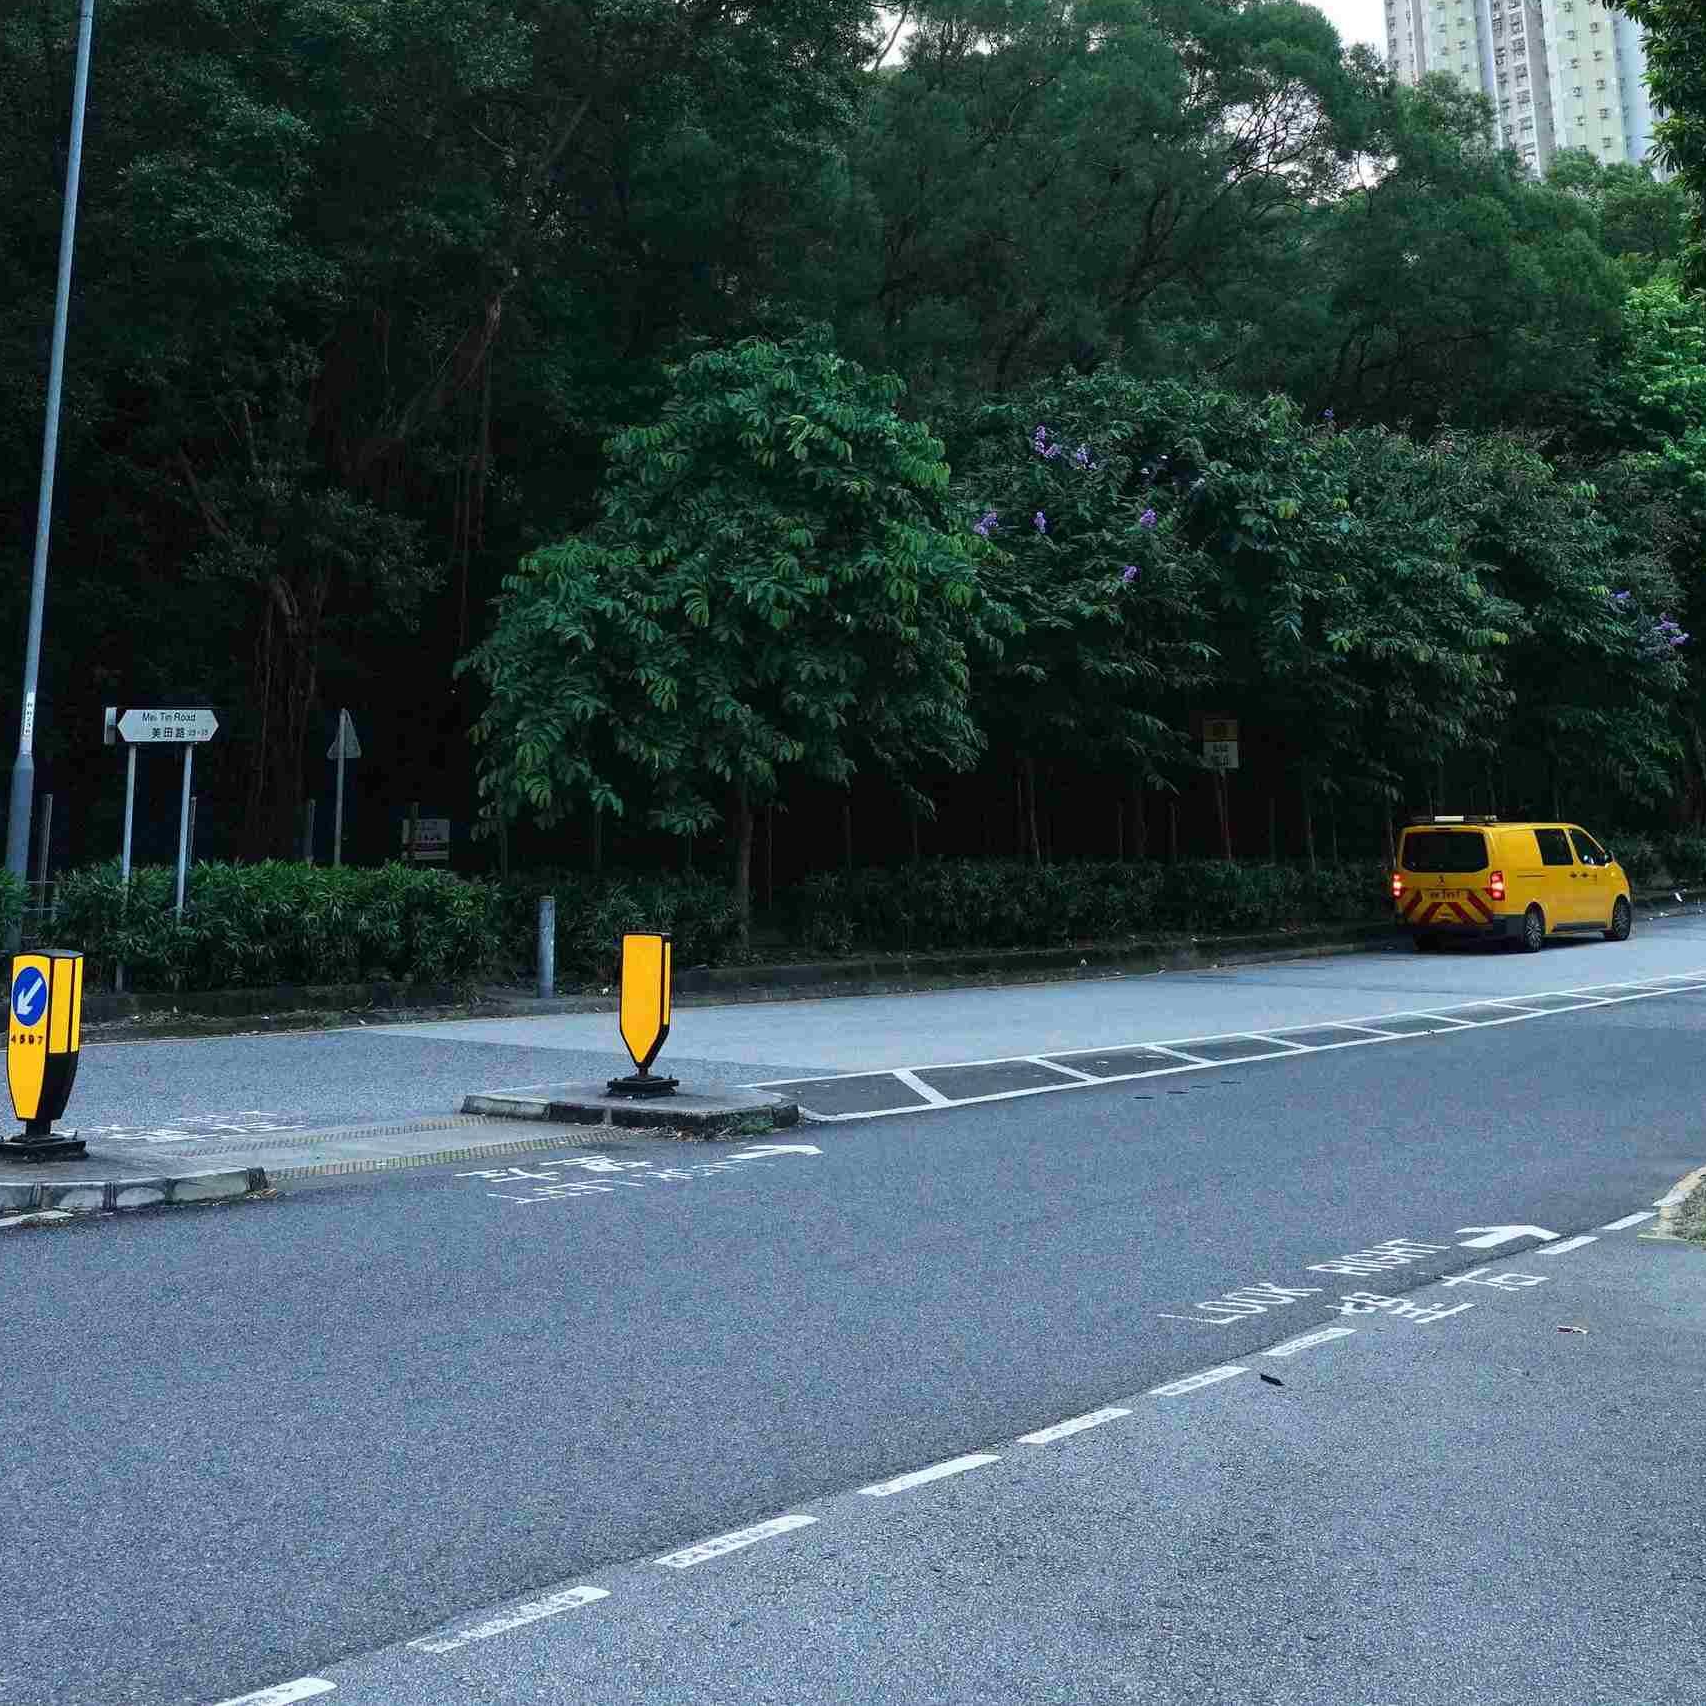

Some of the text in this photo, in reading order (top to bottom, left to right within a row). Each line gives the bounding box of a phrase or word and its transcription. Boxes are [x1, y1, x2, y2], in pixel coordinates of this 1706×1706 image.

[174, 711, 196, 723] Road
[1156, 1237, 1452, 1325] LOOK RIGHT
